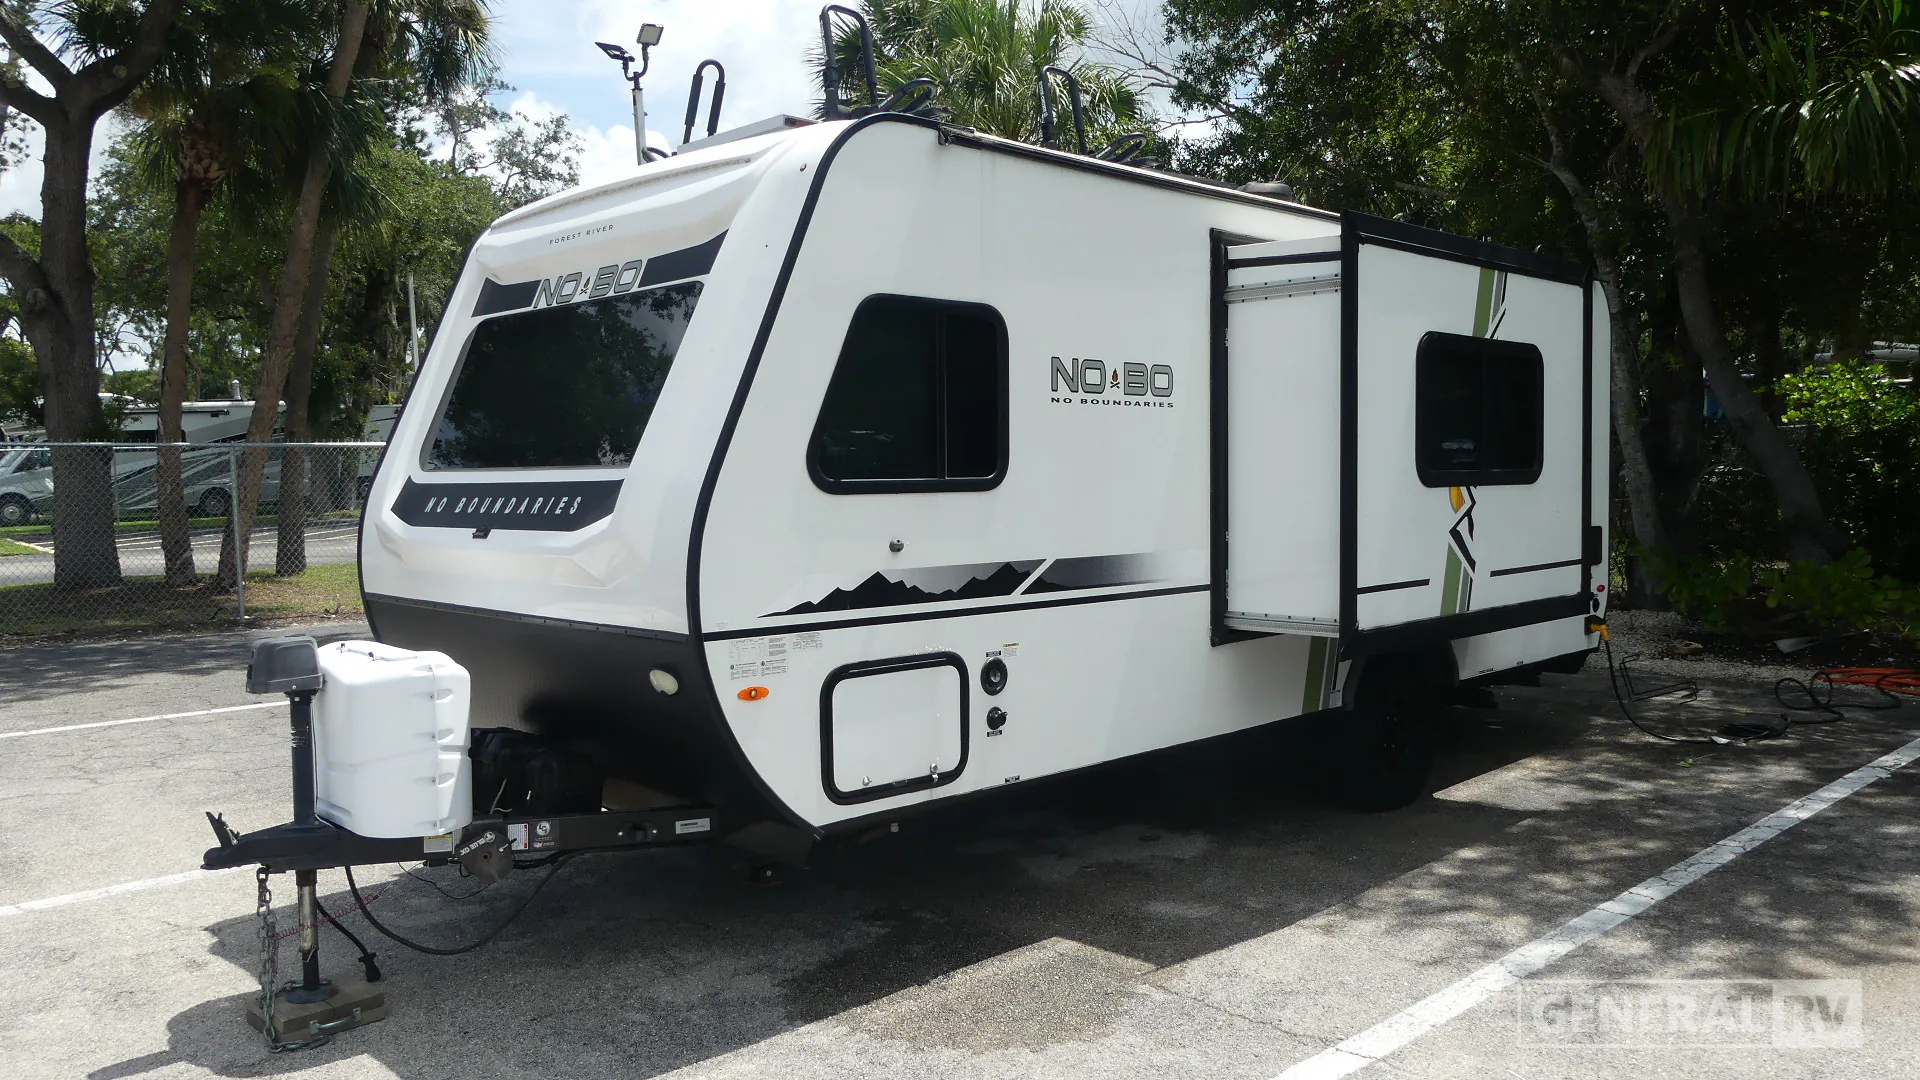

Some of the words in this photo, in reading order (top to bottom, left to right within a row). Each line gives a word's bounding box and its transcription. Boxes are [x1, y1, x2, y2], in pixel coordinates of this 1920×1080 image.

[549, 232, 581, 245] FOREST
[586, 224, 614, 236] RIVER
[1080, 398, 1174, 408] BOUNDARIES
[424, 497, 447, 513] NO
[454, 496, 582, 515] BOUNDARIES
